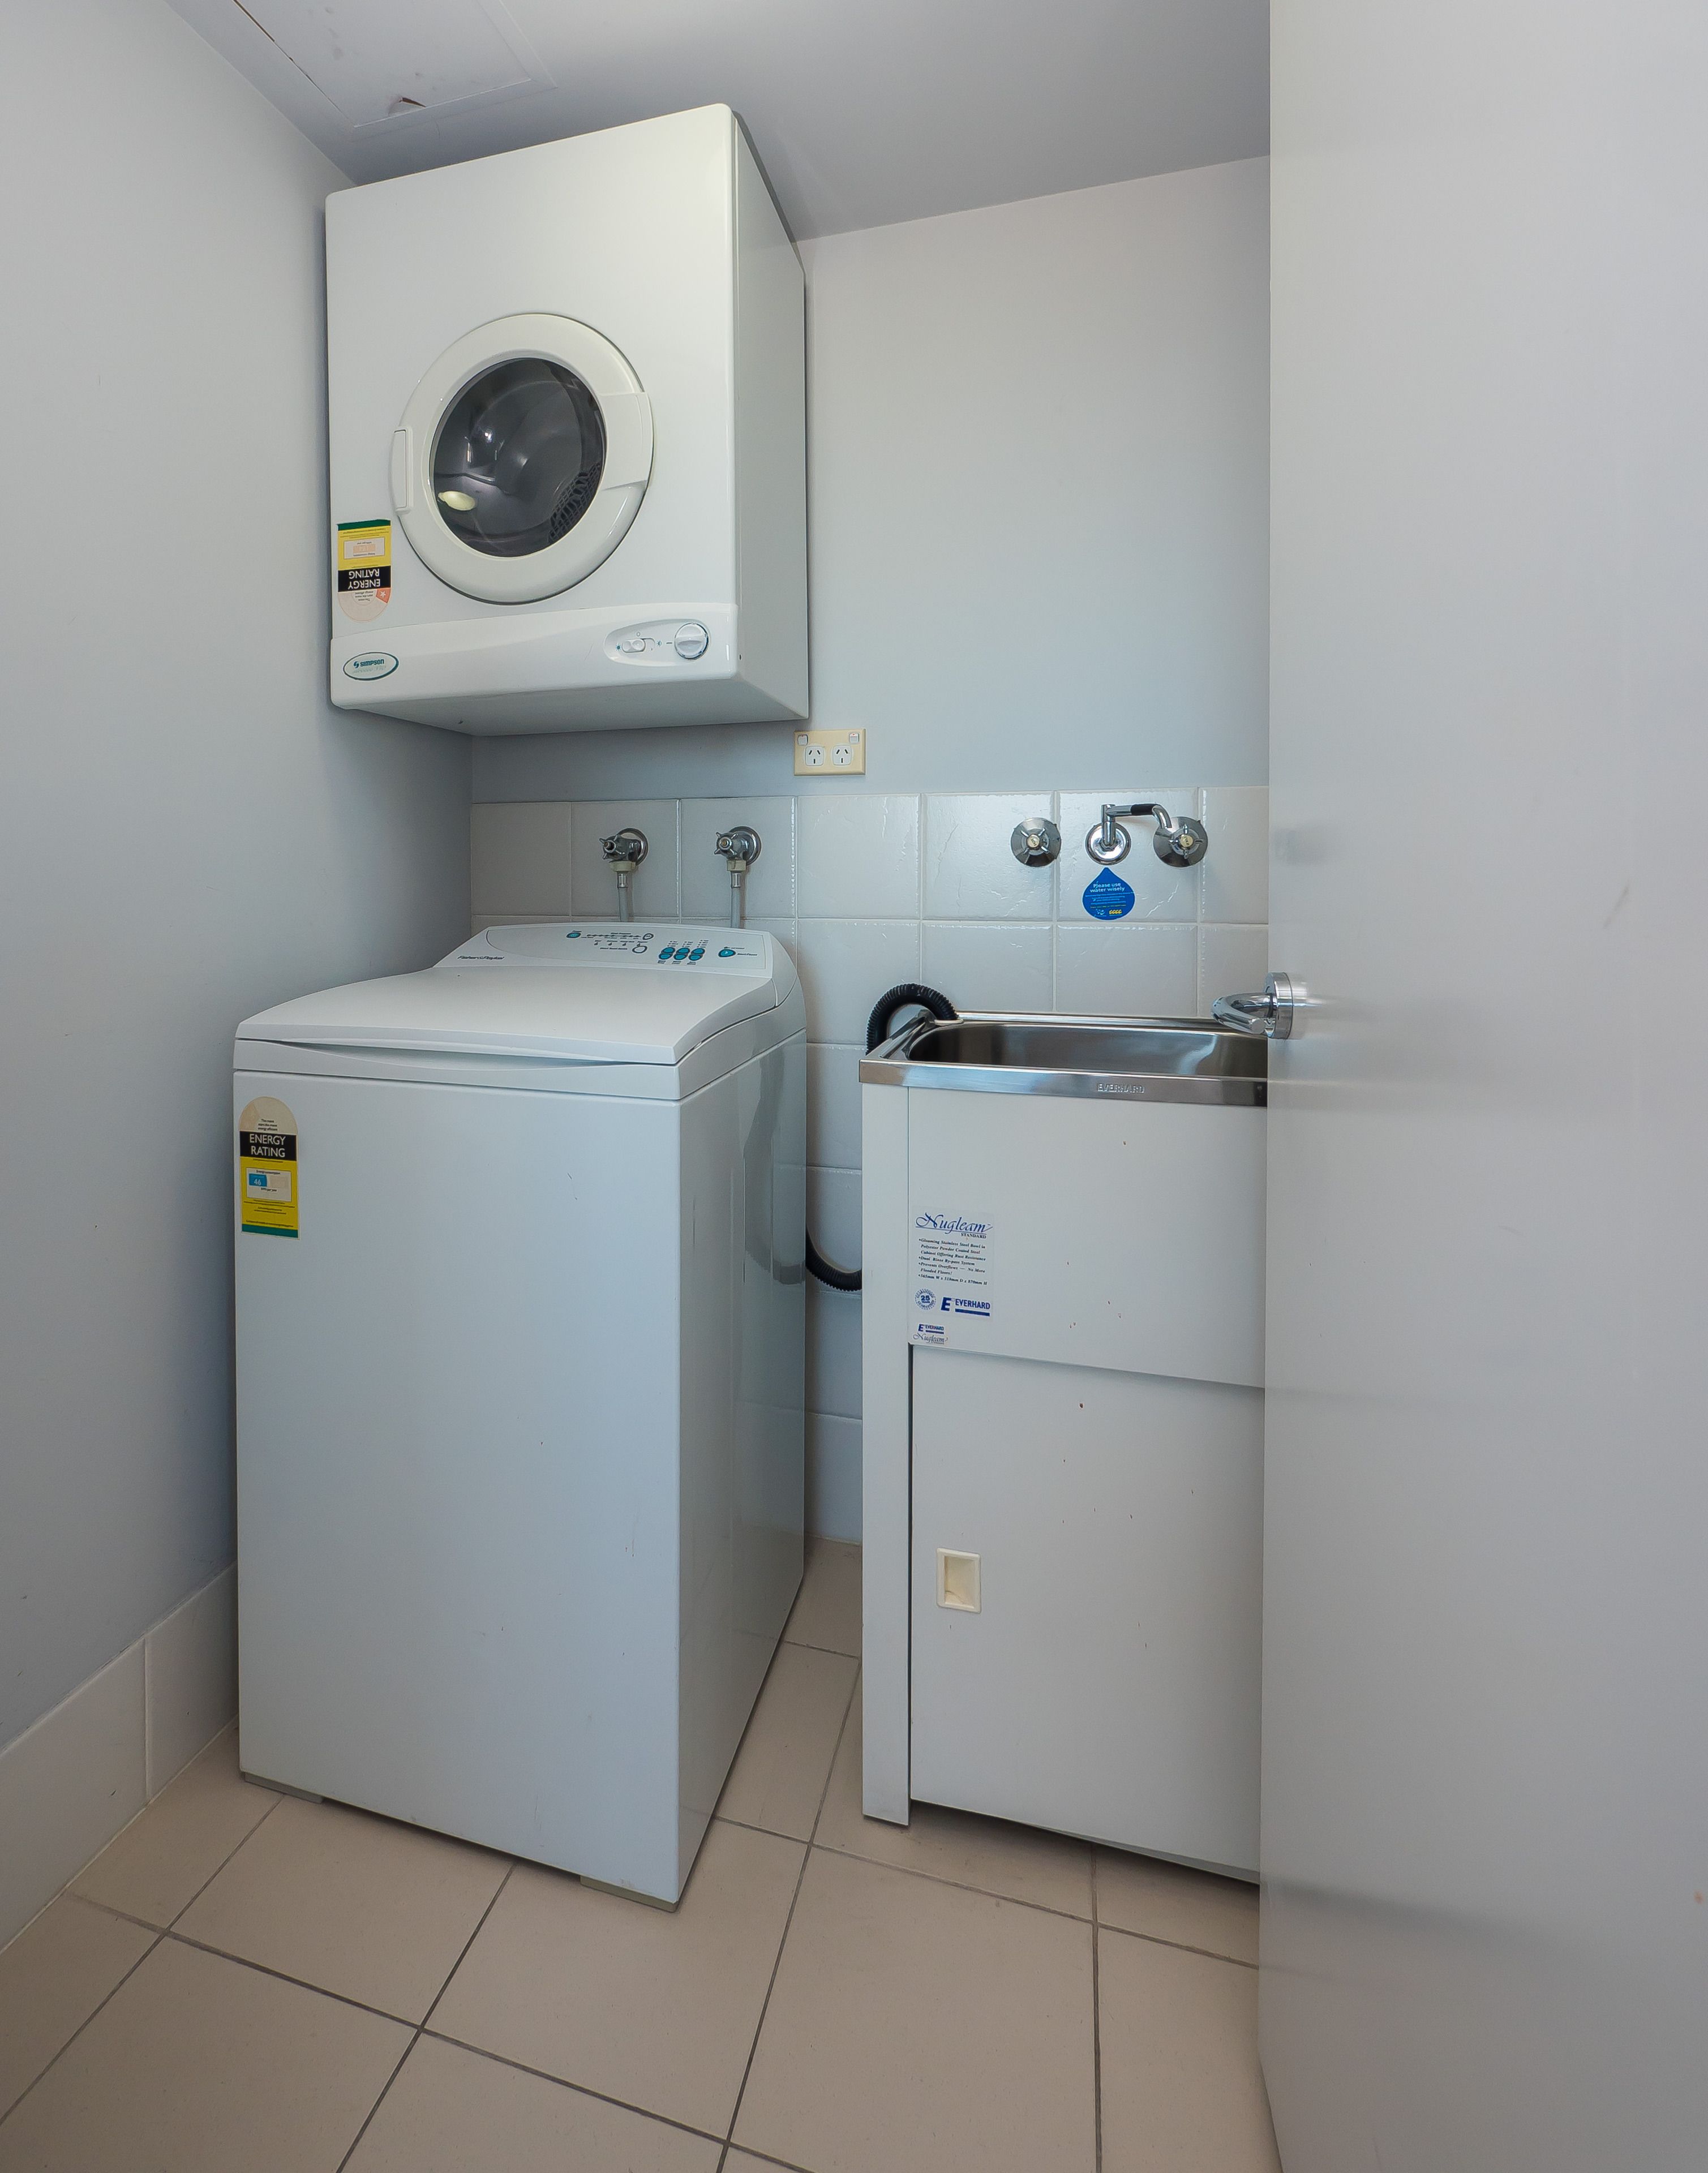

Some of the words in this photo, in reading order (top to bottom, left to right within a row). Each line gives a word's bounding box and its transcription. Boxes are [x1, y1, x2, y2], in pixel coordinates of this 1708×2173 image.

[348, 568, 380, 579] RATING
[347, 578, 381, 590] ENERGY
[250, 1133, 286, 1145] ENERGY
[251, 1146, 285, 1157] RATING
[915, 1212, 992, 1234] Nugleam
[955, 1298, 990, 1309] EVERHARD
